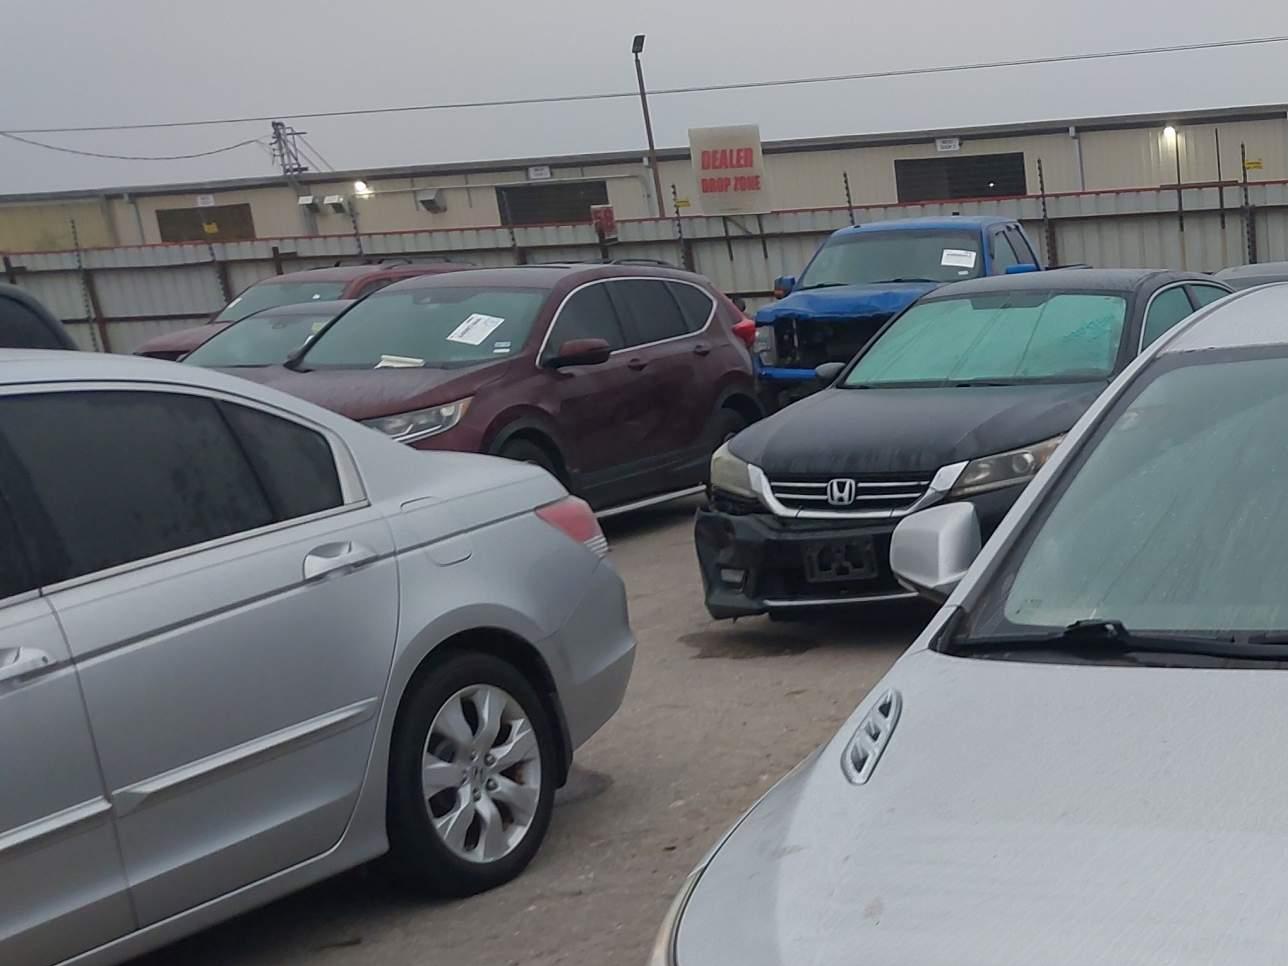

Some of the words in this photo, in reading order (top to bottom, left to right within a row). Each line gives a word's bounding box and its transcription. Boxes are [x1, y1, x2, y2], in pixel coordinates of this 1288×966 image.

[701, 147, 753, 170] DEALER
[701, 177, 731, 193] DROP
[734, 175, 761, 192] ZONE
